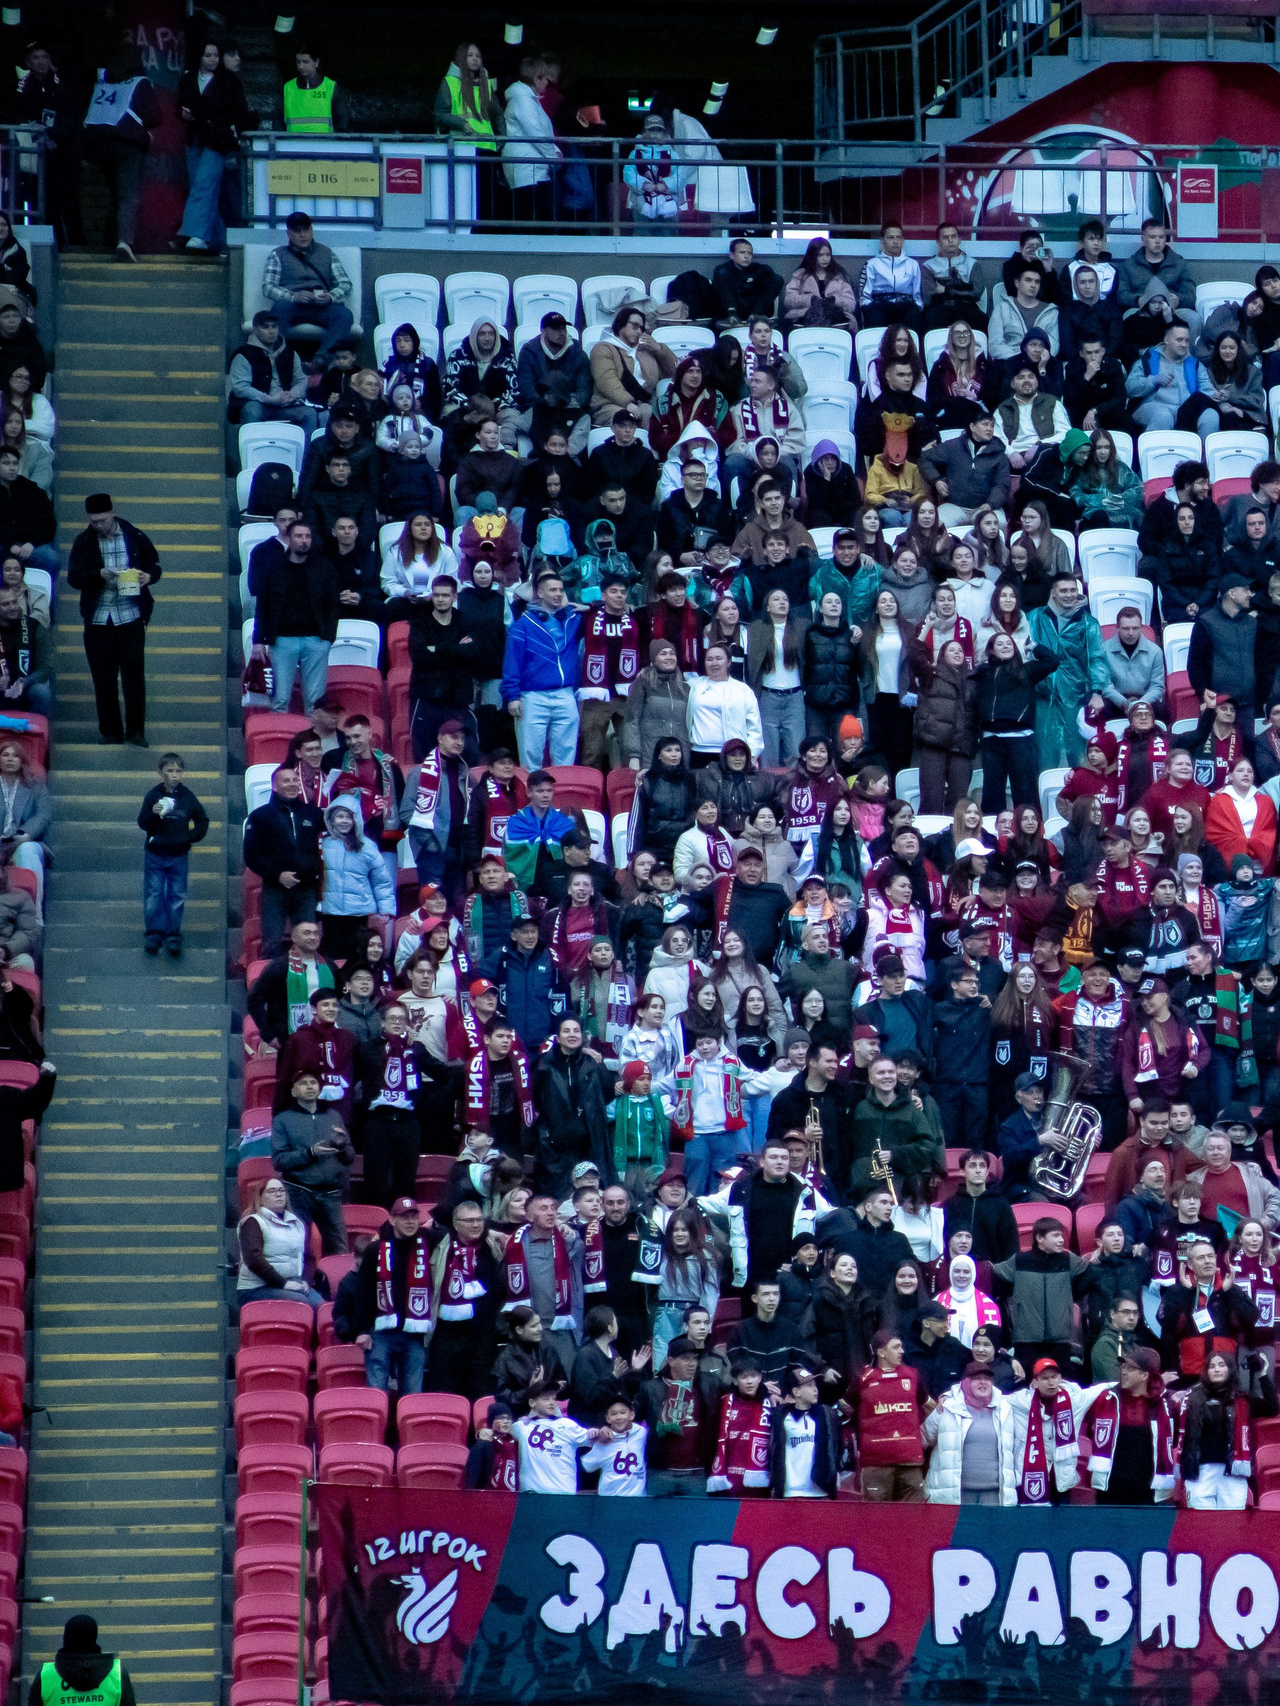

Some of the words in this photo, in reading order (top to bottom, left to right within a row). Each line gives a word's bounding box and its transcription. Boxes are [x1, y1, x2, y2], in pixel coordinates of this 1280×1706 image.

[95, 89, 116, 106] 24
[313, 91, 327, 99] 255
[321, 173, 338, 184] 116
[791, 815, 816, 826] 1958
[380, 1088, 405, 1101] 1958
[365, 1537, 396, 1565] 12
[399, 1530, 487, 1571] ИГРОК
[537, 1533, 892, 1654] ЗДЕСЬ
[60, 1695, 104, 1705] STEWARD
